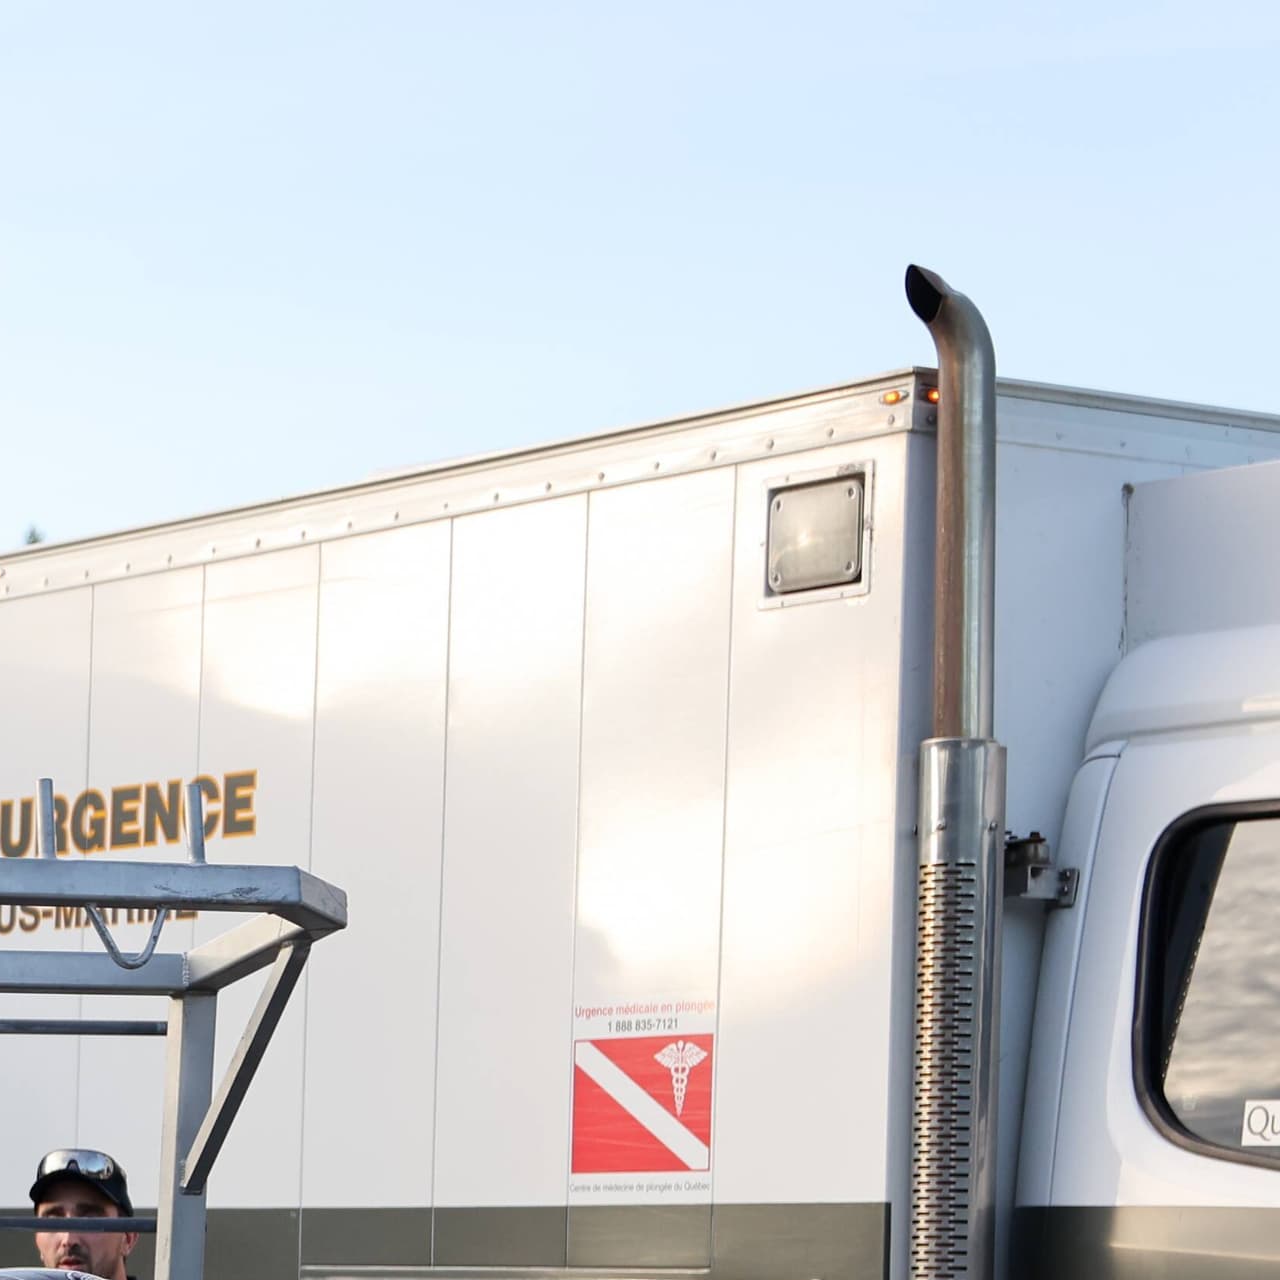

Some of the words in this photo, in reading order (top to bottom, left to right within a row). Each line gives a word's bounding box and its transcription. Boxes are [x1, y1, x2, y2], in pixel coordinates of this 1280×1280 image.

[575, 1005, 613, 1019] Urgence
[616, 1001, 657, 1015] médicale
[661, 1003, 673, 1013] en
[675, 999, 716, 1015] plongée
[635, 1018, 679, 1032] 835-7121
